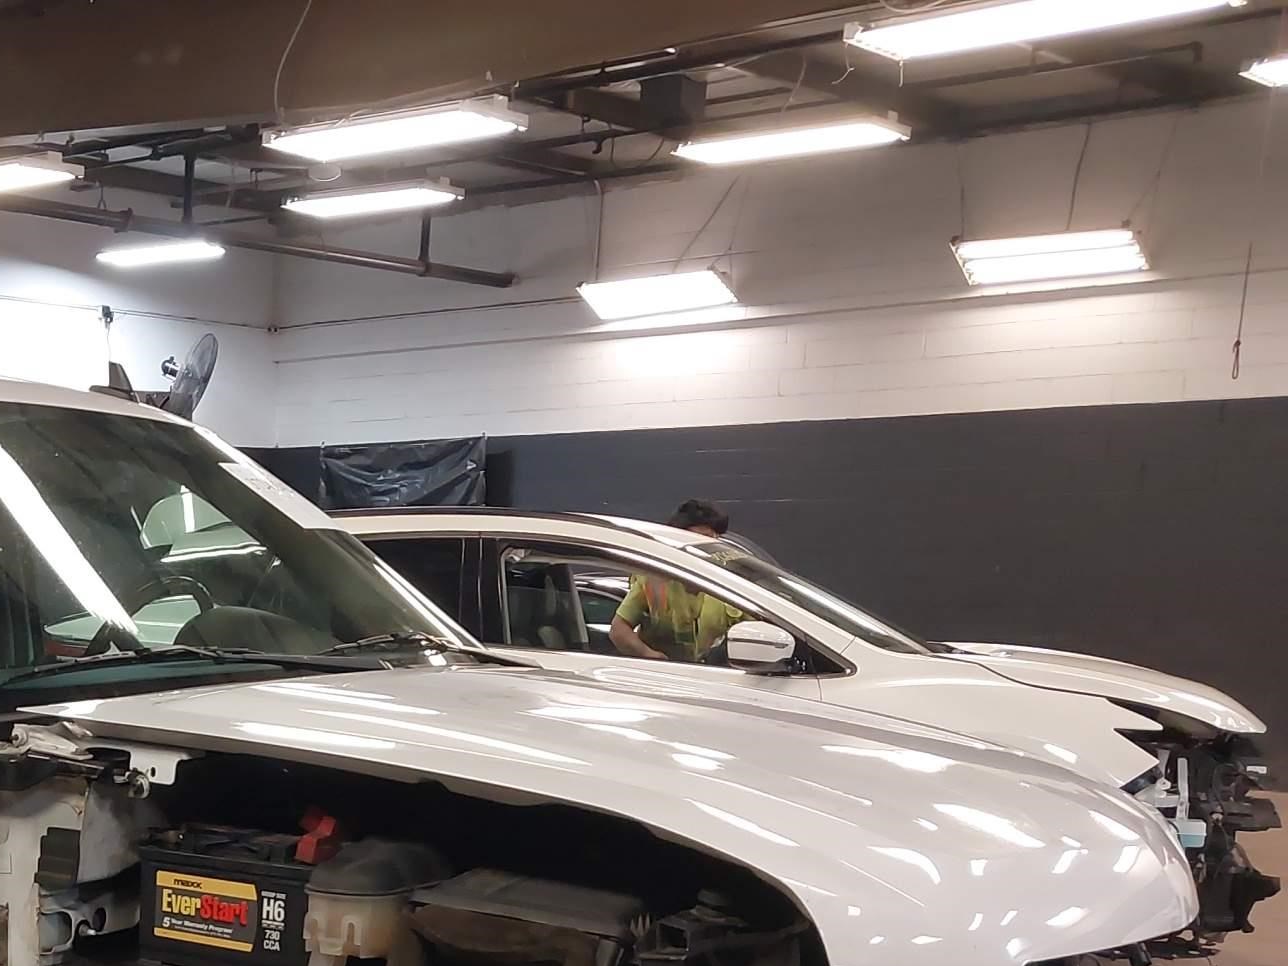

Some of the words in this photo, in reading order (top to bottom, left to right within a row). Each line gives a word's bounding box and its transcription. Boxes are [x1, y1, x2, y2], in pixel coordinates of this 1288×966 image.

[161, 888, 248, 925] EverStart
[262, 897, 285, 922] H6
[162, 916, 171, 928] 5
[264, 929, 281, 941] 730
[263, 939, 281, 952] CCA
